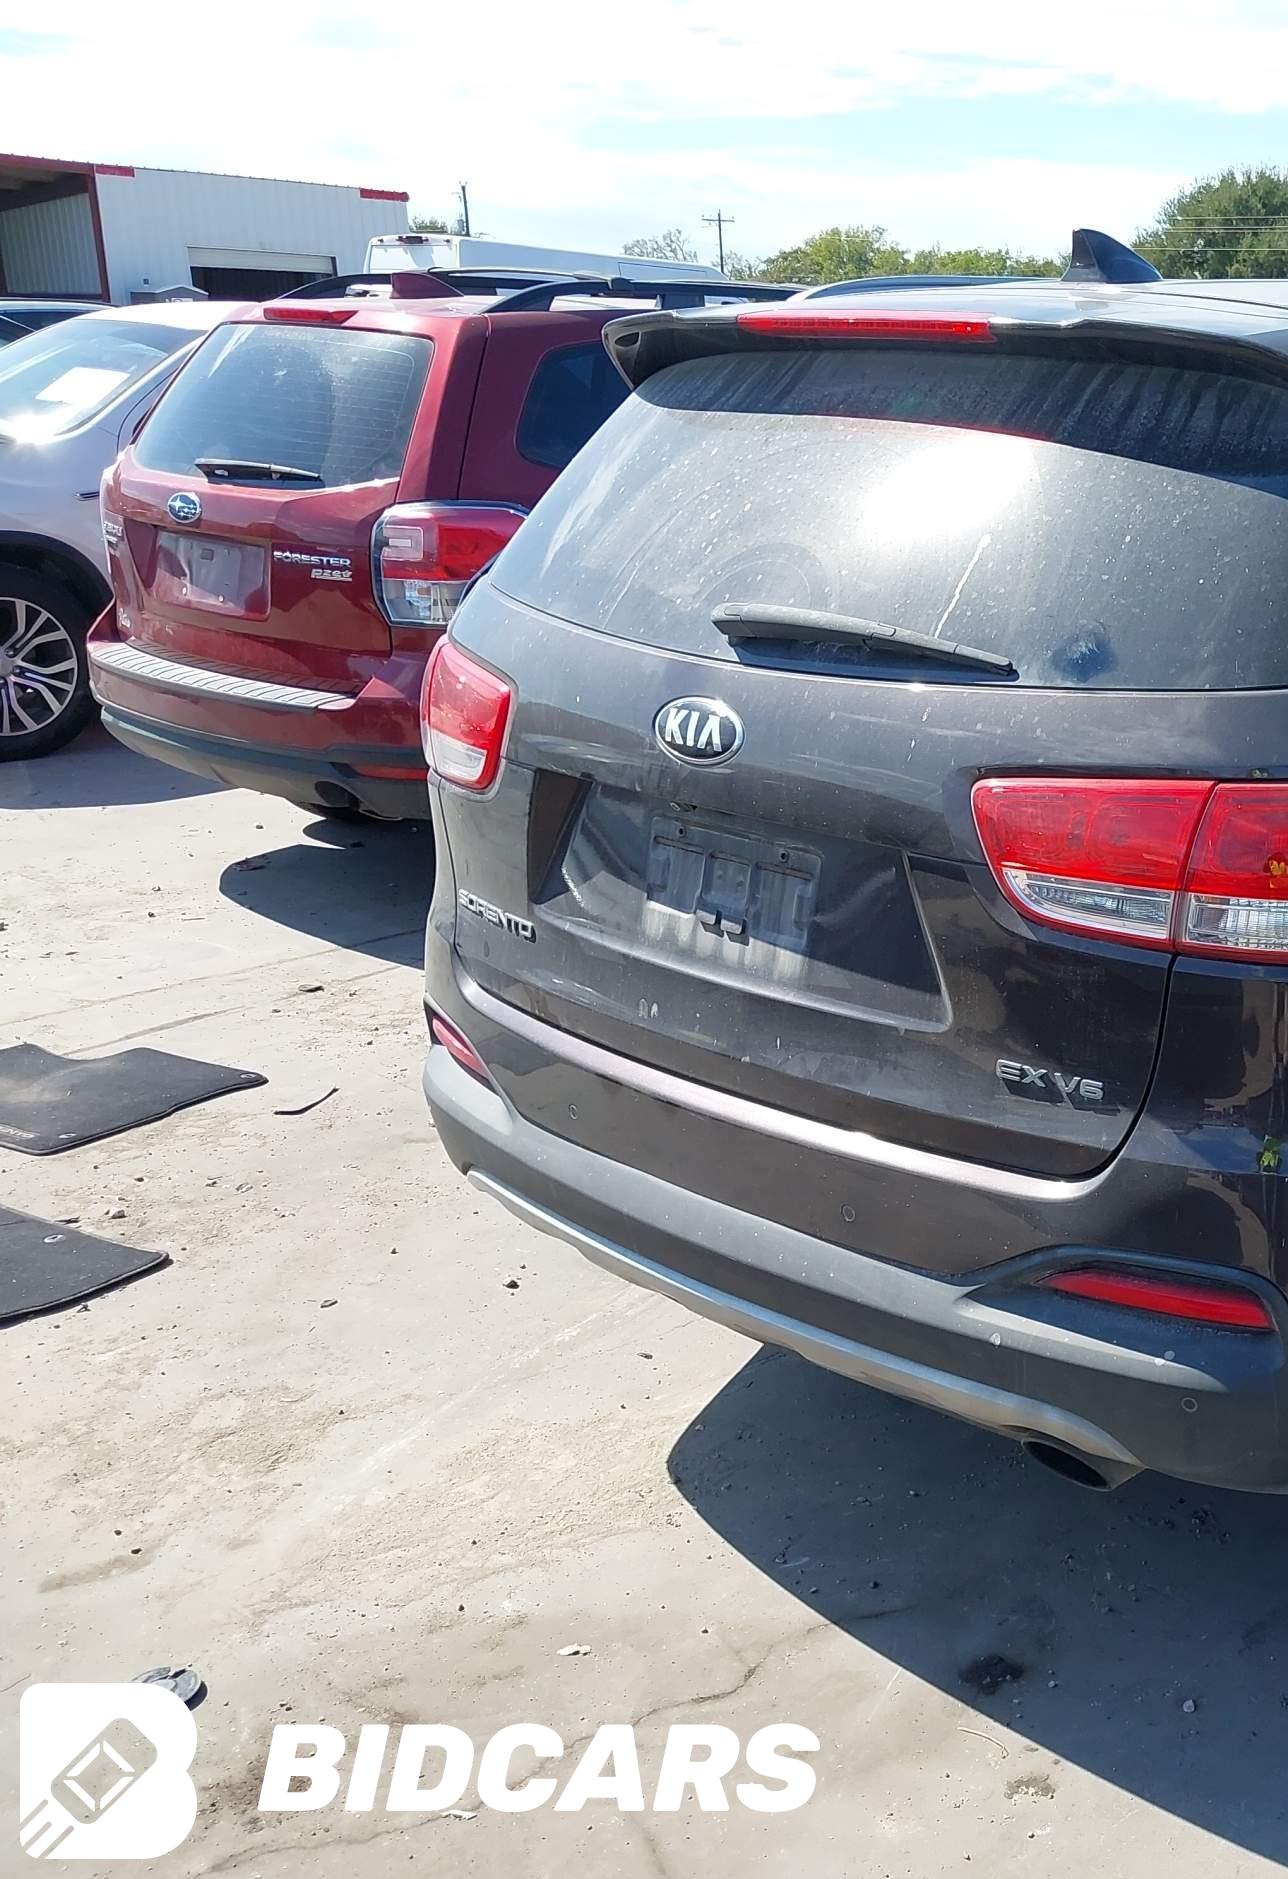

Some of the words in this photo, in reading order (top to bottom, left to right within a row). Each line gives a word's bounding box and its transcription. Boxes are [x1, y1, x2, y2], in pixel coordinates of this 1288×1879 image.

[273, 549, 352, 568] FORESTER
[664, 706, 723, 753] KIA
[458, 888, 535, 939] SORENTO
[995, 1059, 1048, 1088] EX
[1054, 1072, 1104, 1101] V6
